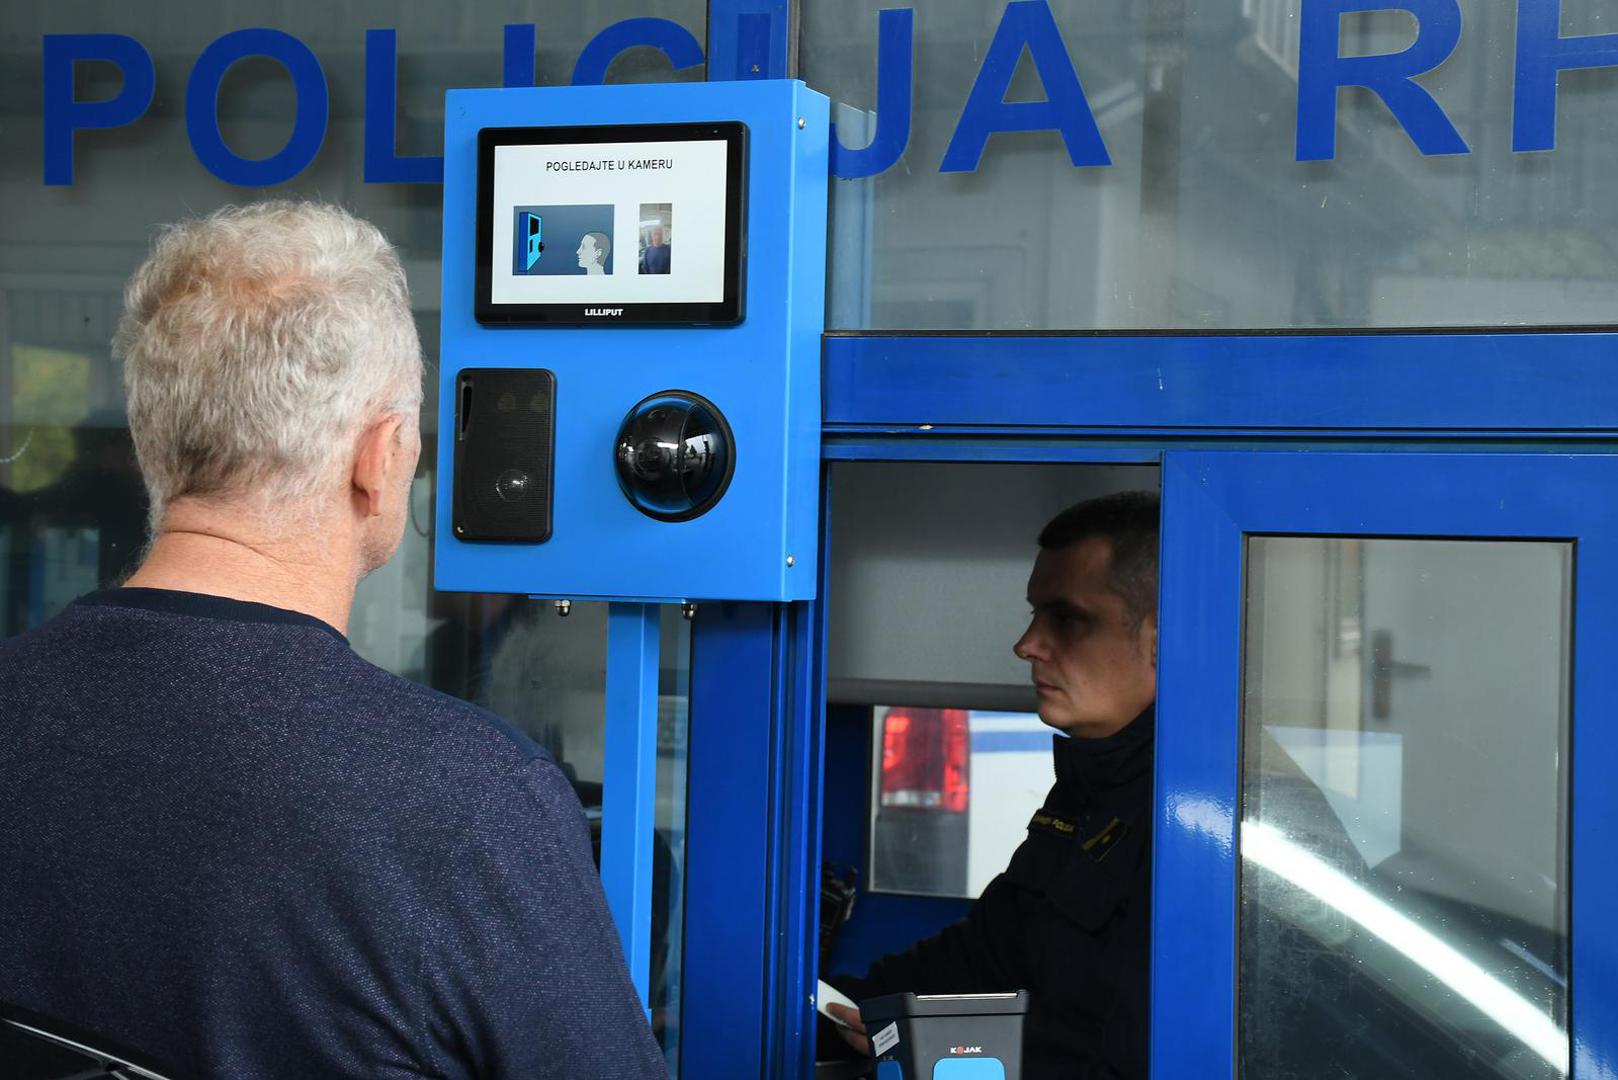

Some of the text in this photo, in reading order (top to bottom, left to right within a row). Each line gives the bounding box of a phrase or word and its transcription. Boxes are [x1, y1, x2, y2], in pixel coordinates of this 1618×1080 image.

[546, 159, 673, 172] POGLEDAJTE U KAMERU
[584, 308, 624, 316] LILLIPUT
[950, 1046, 982, 1055] KOJAK
